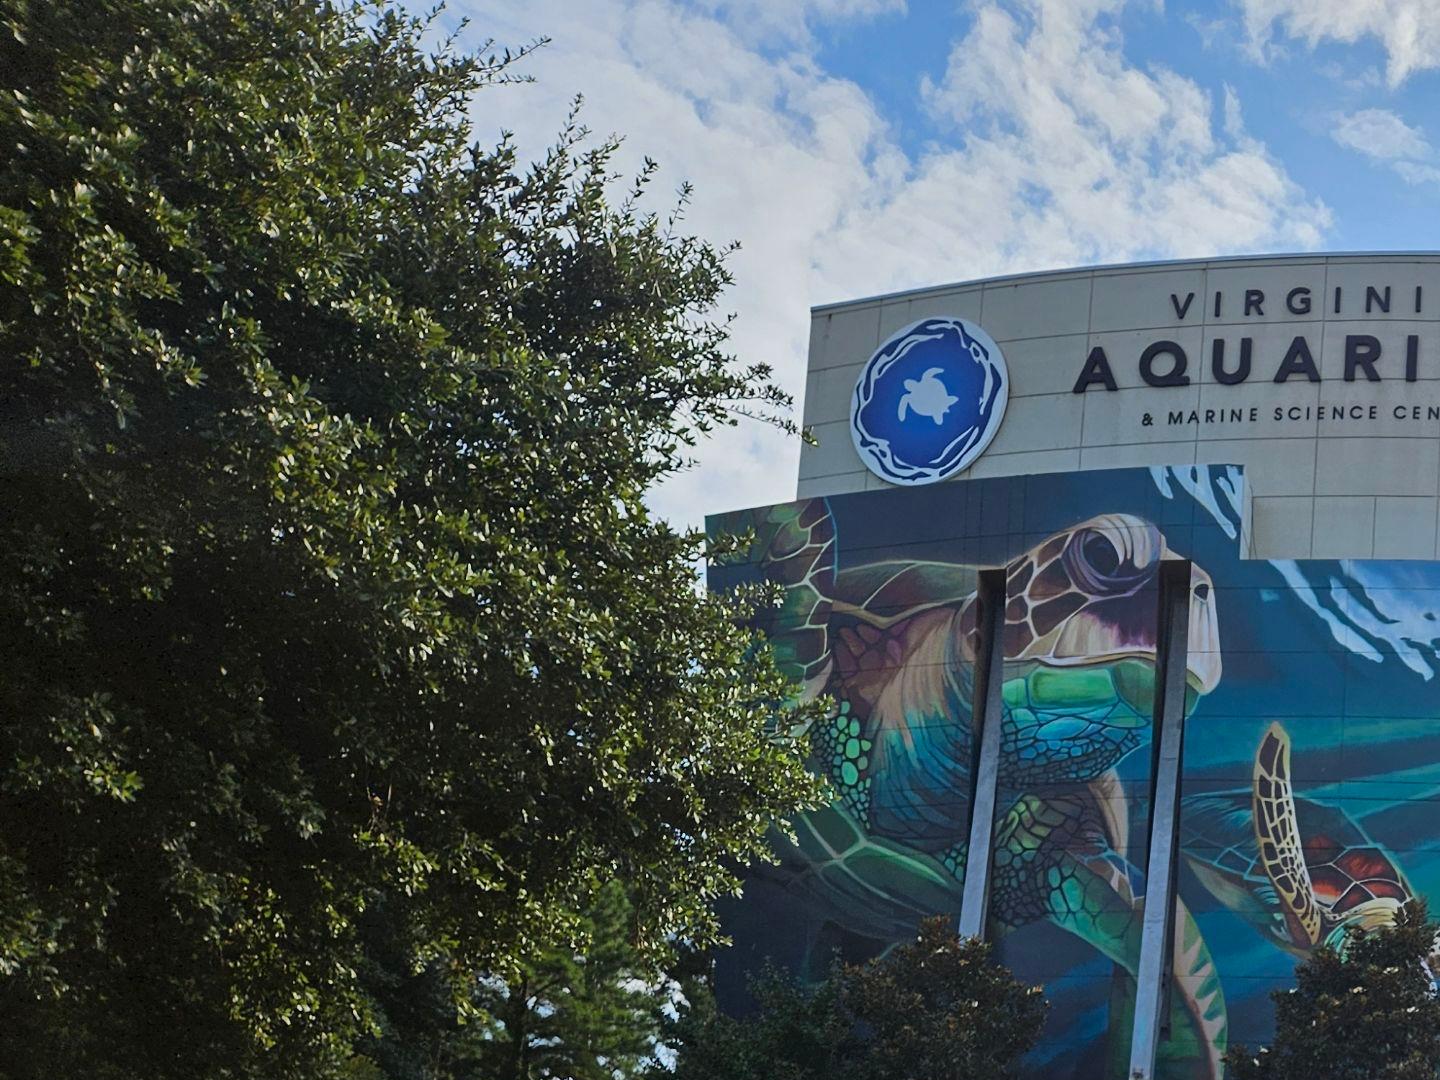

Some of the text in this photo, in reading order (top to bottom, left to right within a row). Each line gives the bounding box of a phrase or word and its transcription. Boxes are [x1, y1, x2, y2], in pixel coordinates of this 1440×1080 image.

[1141, 412, 1154, 427] &
[1168, 408, 1258, 425] MARINE
[1274, 405, 1378, 422] SCIENCE
